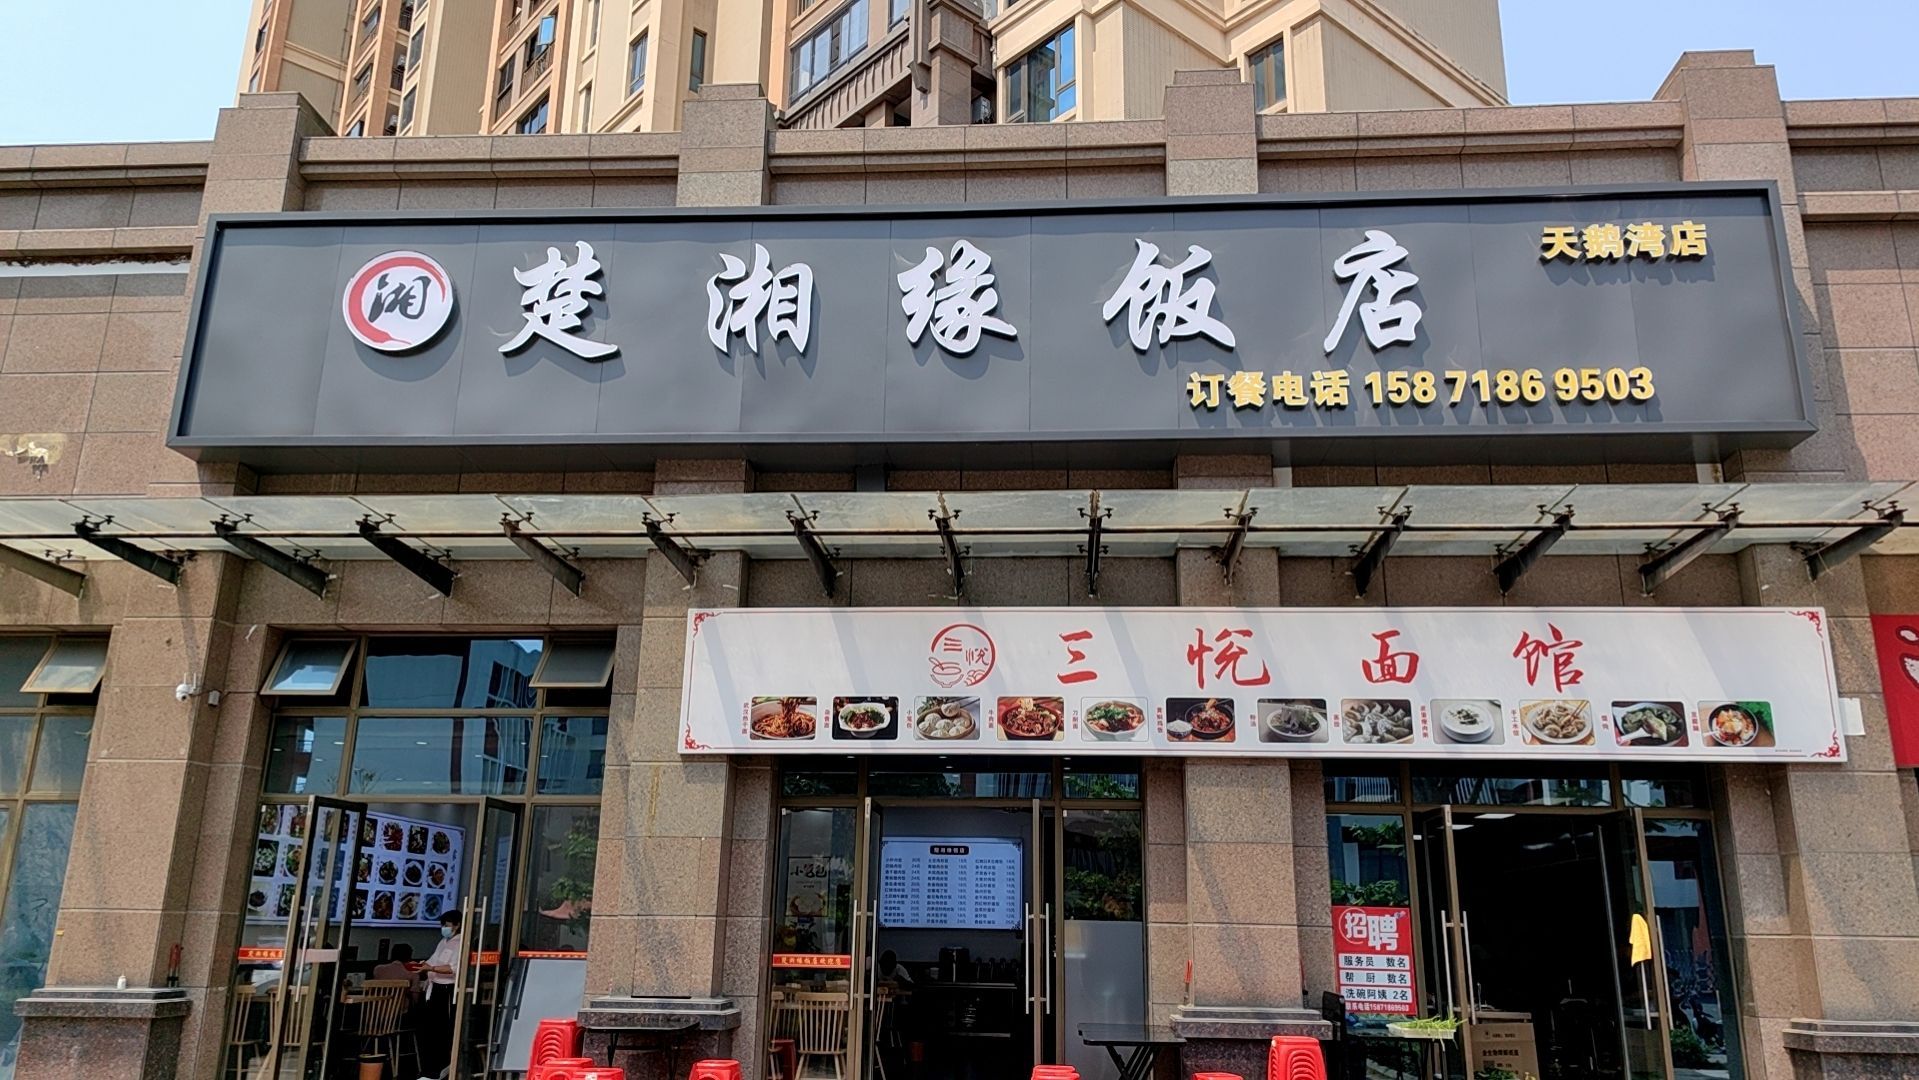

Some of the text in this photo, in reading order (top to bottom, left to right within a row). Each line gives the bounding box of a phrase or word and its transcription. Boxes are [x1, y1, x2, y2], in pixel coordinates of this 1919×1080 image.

[1540, 220, 1708, 260] 天鹅湾店
[371, 272, 430, 320] 湘
[498, 230, 1423, 360] 楚湘缘饭店
[1187, 366, 1656, 409] 订餐电话 158 7186 9503
[1057, 622, 1585, 694] 三悦面馆
[1345, 912, 1399, 951] 招聘
[1343, 955, 1406, 968] 服务员 数名
[1387, 973, 1407, 984] 数名
[1345, 988, 1408, 1001] 洗碗阿姨 2名
